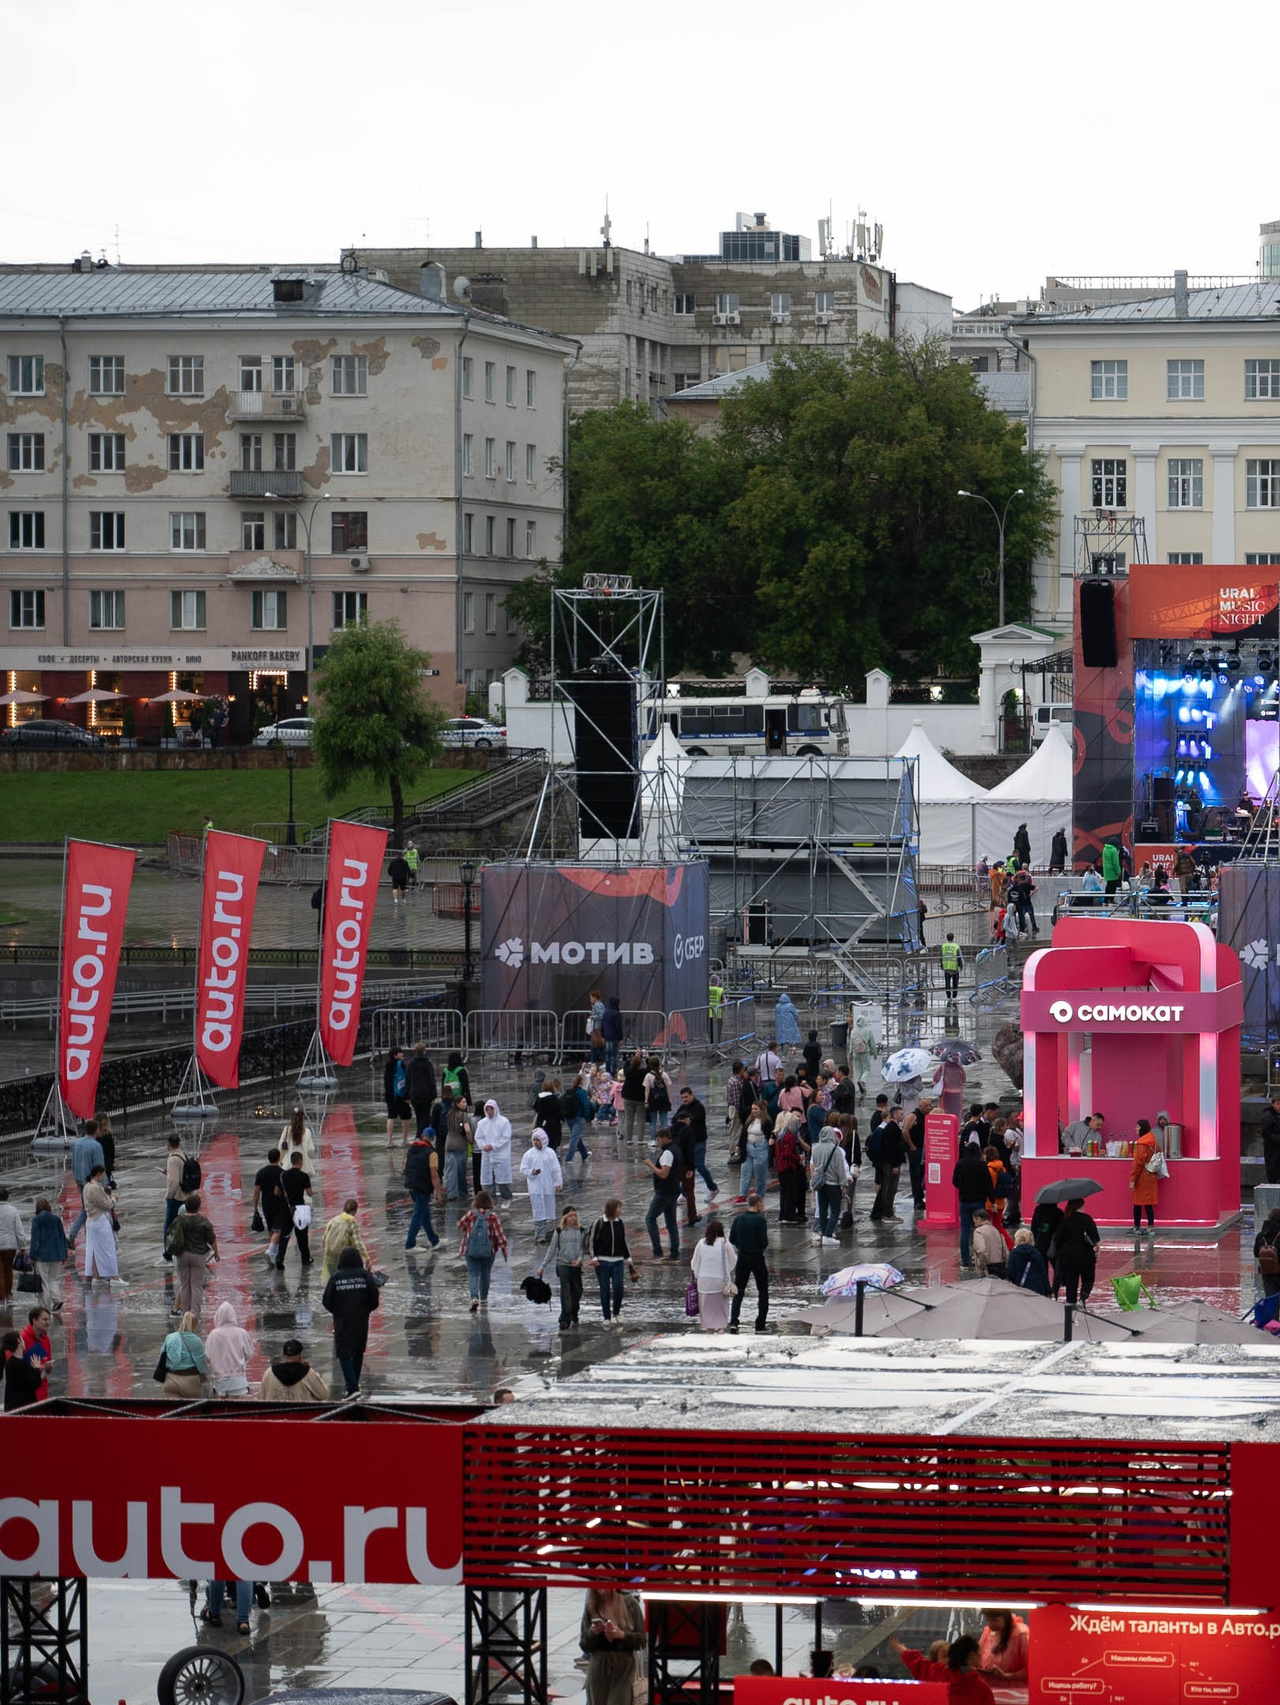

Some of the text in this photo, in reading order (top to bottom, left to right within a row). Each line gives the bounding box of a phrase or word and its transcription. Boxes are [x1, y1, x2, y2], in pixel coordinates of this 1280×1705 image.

[1219, 587, 1260, 599] URAL
[1219, 600, 1266, 613] MUSIC
[1219, 613, 1265, 625] NIGHT
[112, 655, 149, 663] АВТОРСКАЯ
[269, 650, 300, 661] BAKERY
[329, 858, 369, 1031] auto.ru
[530, 941, 655, 965] МОТИВ
[684, 934, 705, 961] СБЕР
[201, 870, 245, 1052] auto.ru
[66, 883, 113, 1081] auto.ru
[0, 1485, 464, 1585] auto.ru
[1069, 1615, 1125, 1635] Ждём
[1128, 1619, 1203, 1635] таланты
[1207, 1621, 1218, 1635] в
